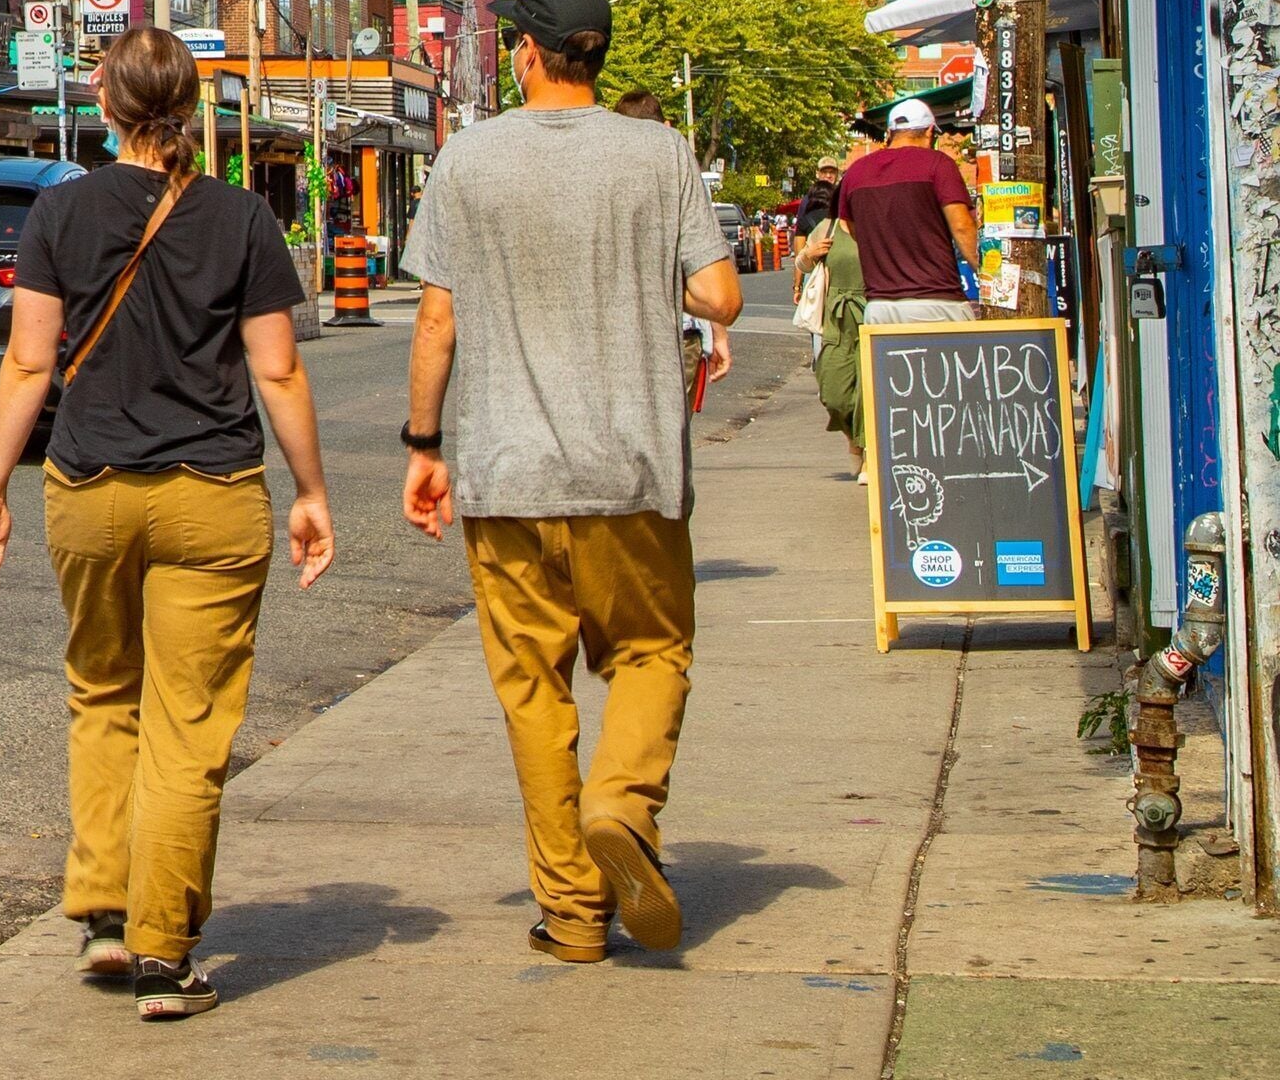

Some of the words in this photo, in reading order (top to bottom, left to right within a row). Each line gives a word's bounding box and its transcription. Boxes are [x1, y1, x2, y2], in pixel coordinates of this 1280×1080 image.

[88, 12, 124, 23] BICYCLES
[87, 23, 125, 33] EXCEPTED
[1001, 30, 1011, 48] OS
[1001, 50, 1013, 152] 83739
[886, 343, 1053, 401] JUMBO
[889, 397, 1062, 461] EMPANADAS
[922, 555, 952, 564] SHOP
[920, 564, 955, 572] SMALL
